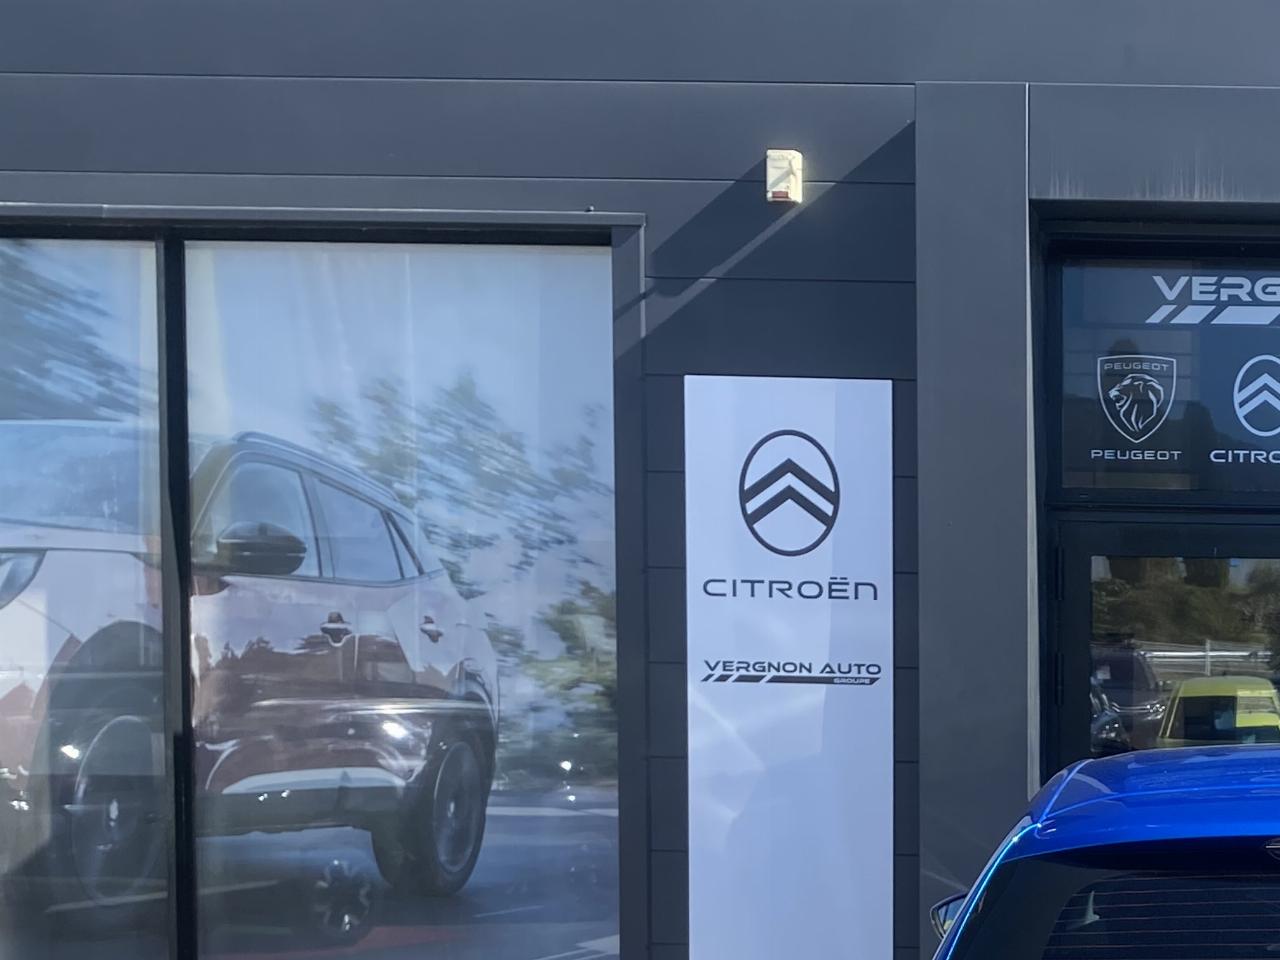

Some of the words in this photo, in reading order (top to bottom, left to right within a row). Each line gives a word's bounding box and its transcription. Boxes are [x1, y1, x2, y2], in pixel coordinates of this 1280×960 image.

[1103, 360, 1170, 372] PEUGEOT
[1090, 449, 1182, 461] PEUGEOT
[702, 577, 879, 601] CITROËN
[704, 660, 812, 674] VERGNON
[819, 663, 882, 675] AUTO
[833, 677, 871, 685] GROUPE
